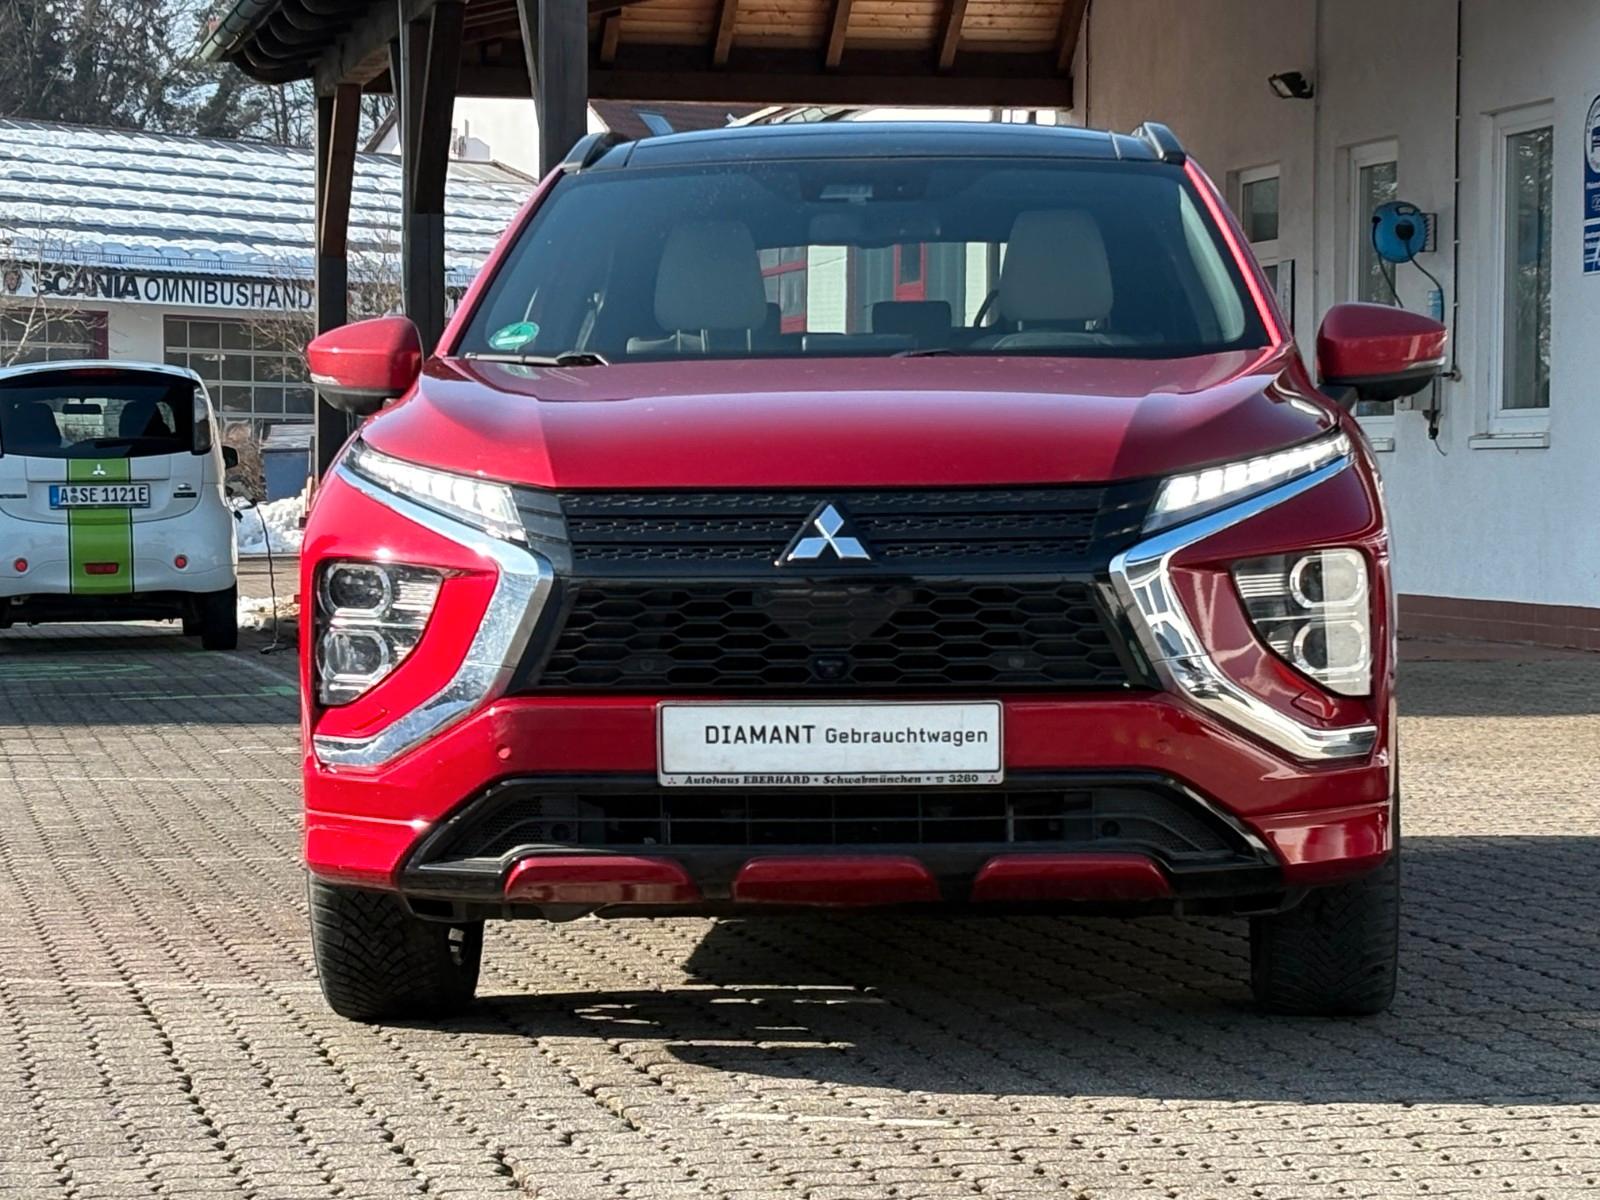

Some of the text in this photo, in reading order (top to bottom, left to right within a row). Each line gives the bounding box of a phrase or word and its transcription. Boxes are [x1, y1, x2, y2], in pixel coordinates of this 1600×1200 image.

[31, 270, 140, 298] SCANIA
[101, 487, 147, 502] 1121E
[705, 725, 988, 747] DIAMANT Gebrauchtwagen
[684, 774, 979, 785] Autohaus EBERHARD Schwabmünchen 3280
